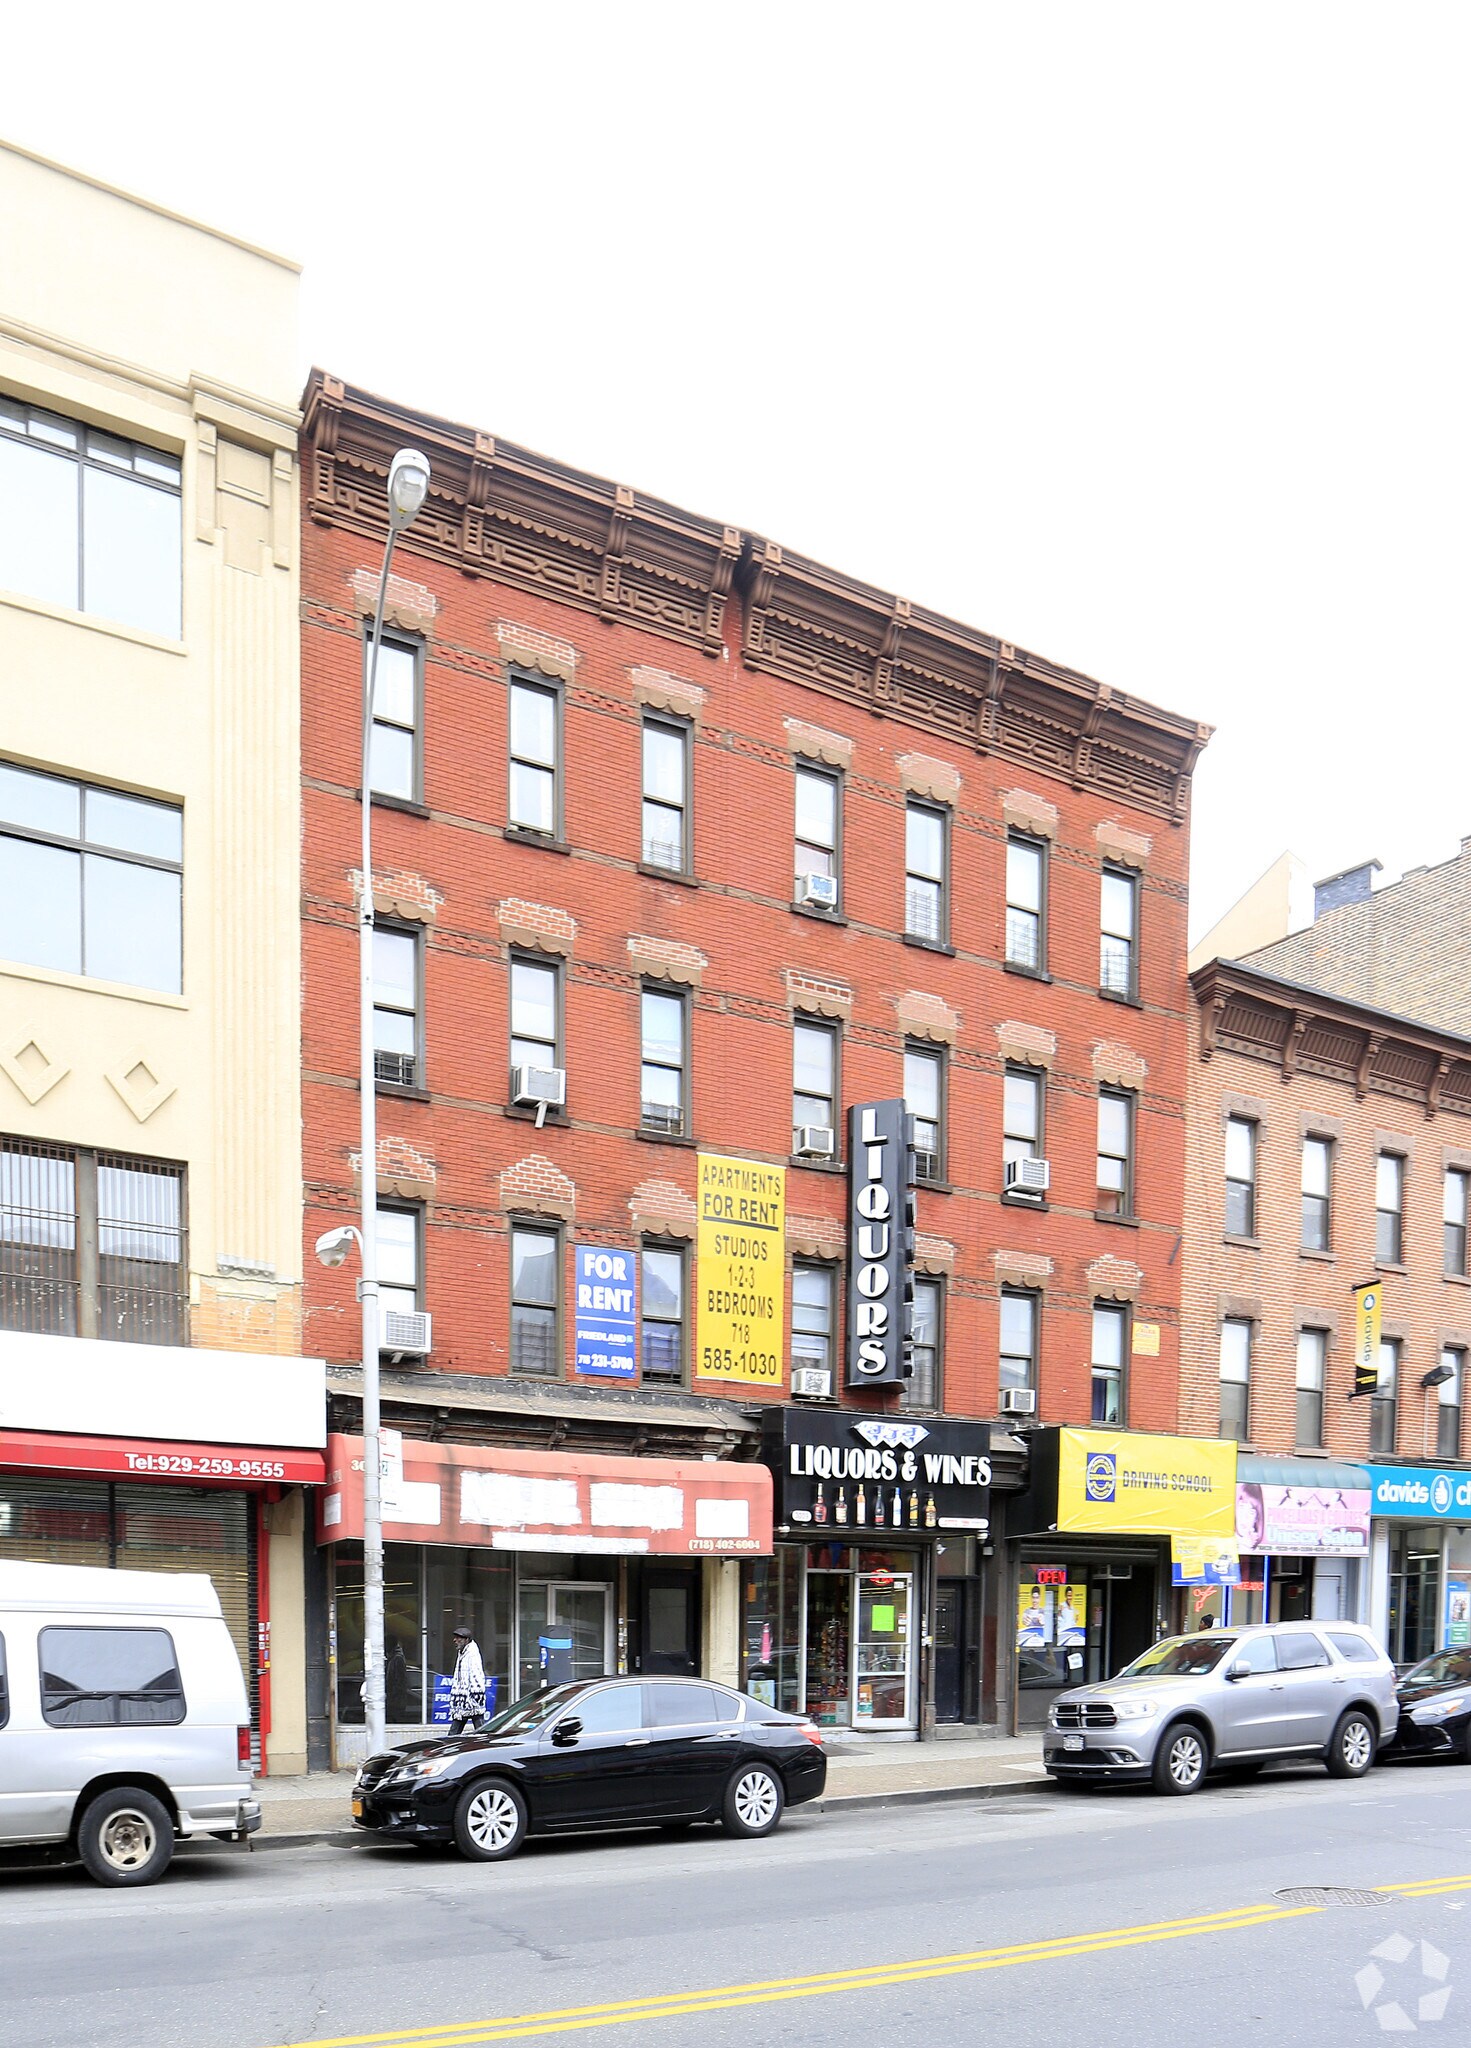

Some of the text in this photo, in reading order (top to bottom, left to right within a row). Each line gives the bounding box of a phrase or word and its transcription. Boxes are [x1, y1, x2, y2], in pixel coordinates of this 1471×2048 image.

[702, 1164, 781, 1197] APARTMENTS
[704, 1193, 779, 1225] FOR RENT
[715, 1234, 768, 1261] STUDIOS
[857, 1109, 889, 1375] LIQUORS
[584, 1253, 627, 1281] FOR
[578, 1284, 633, 1313] RENT
[708, 1289, 774, 1319] BEDROOMS
[577, 1330, 627, 1344] FRIEDLAND
[732, 1322, 750, 1344] 718
[578, 1354, 634, 1371] 718 231-5700
[703, 1347, 777, 1376] 585-1030
[124, 1453, 285, 1478] Tel:929-259-9555
[790, 1443, 992, 1486] LIQUORS & WINES
[1122, 1470, 1168, 1490] DRIVING
[1171, 1473, 1213, 1493] SCHOOL
[1377, 1480, 1430, 1504] davids
[688, 1539, 714, 1551] (718)
[1267, 1525, 1364, 1546] Unisex Salon
[1038, 1570, 1067, 1584] OPEN
